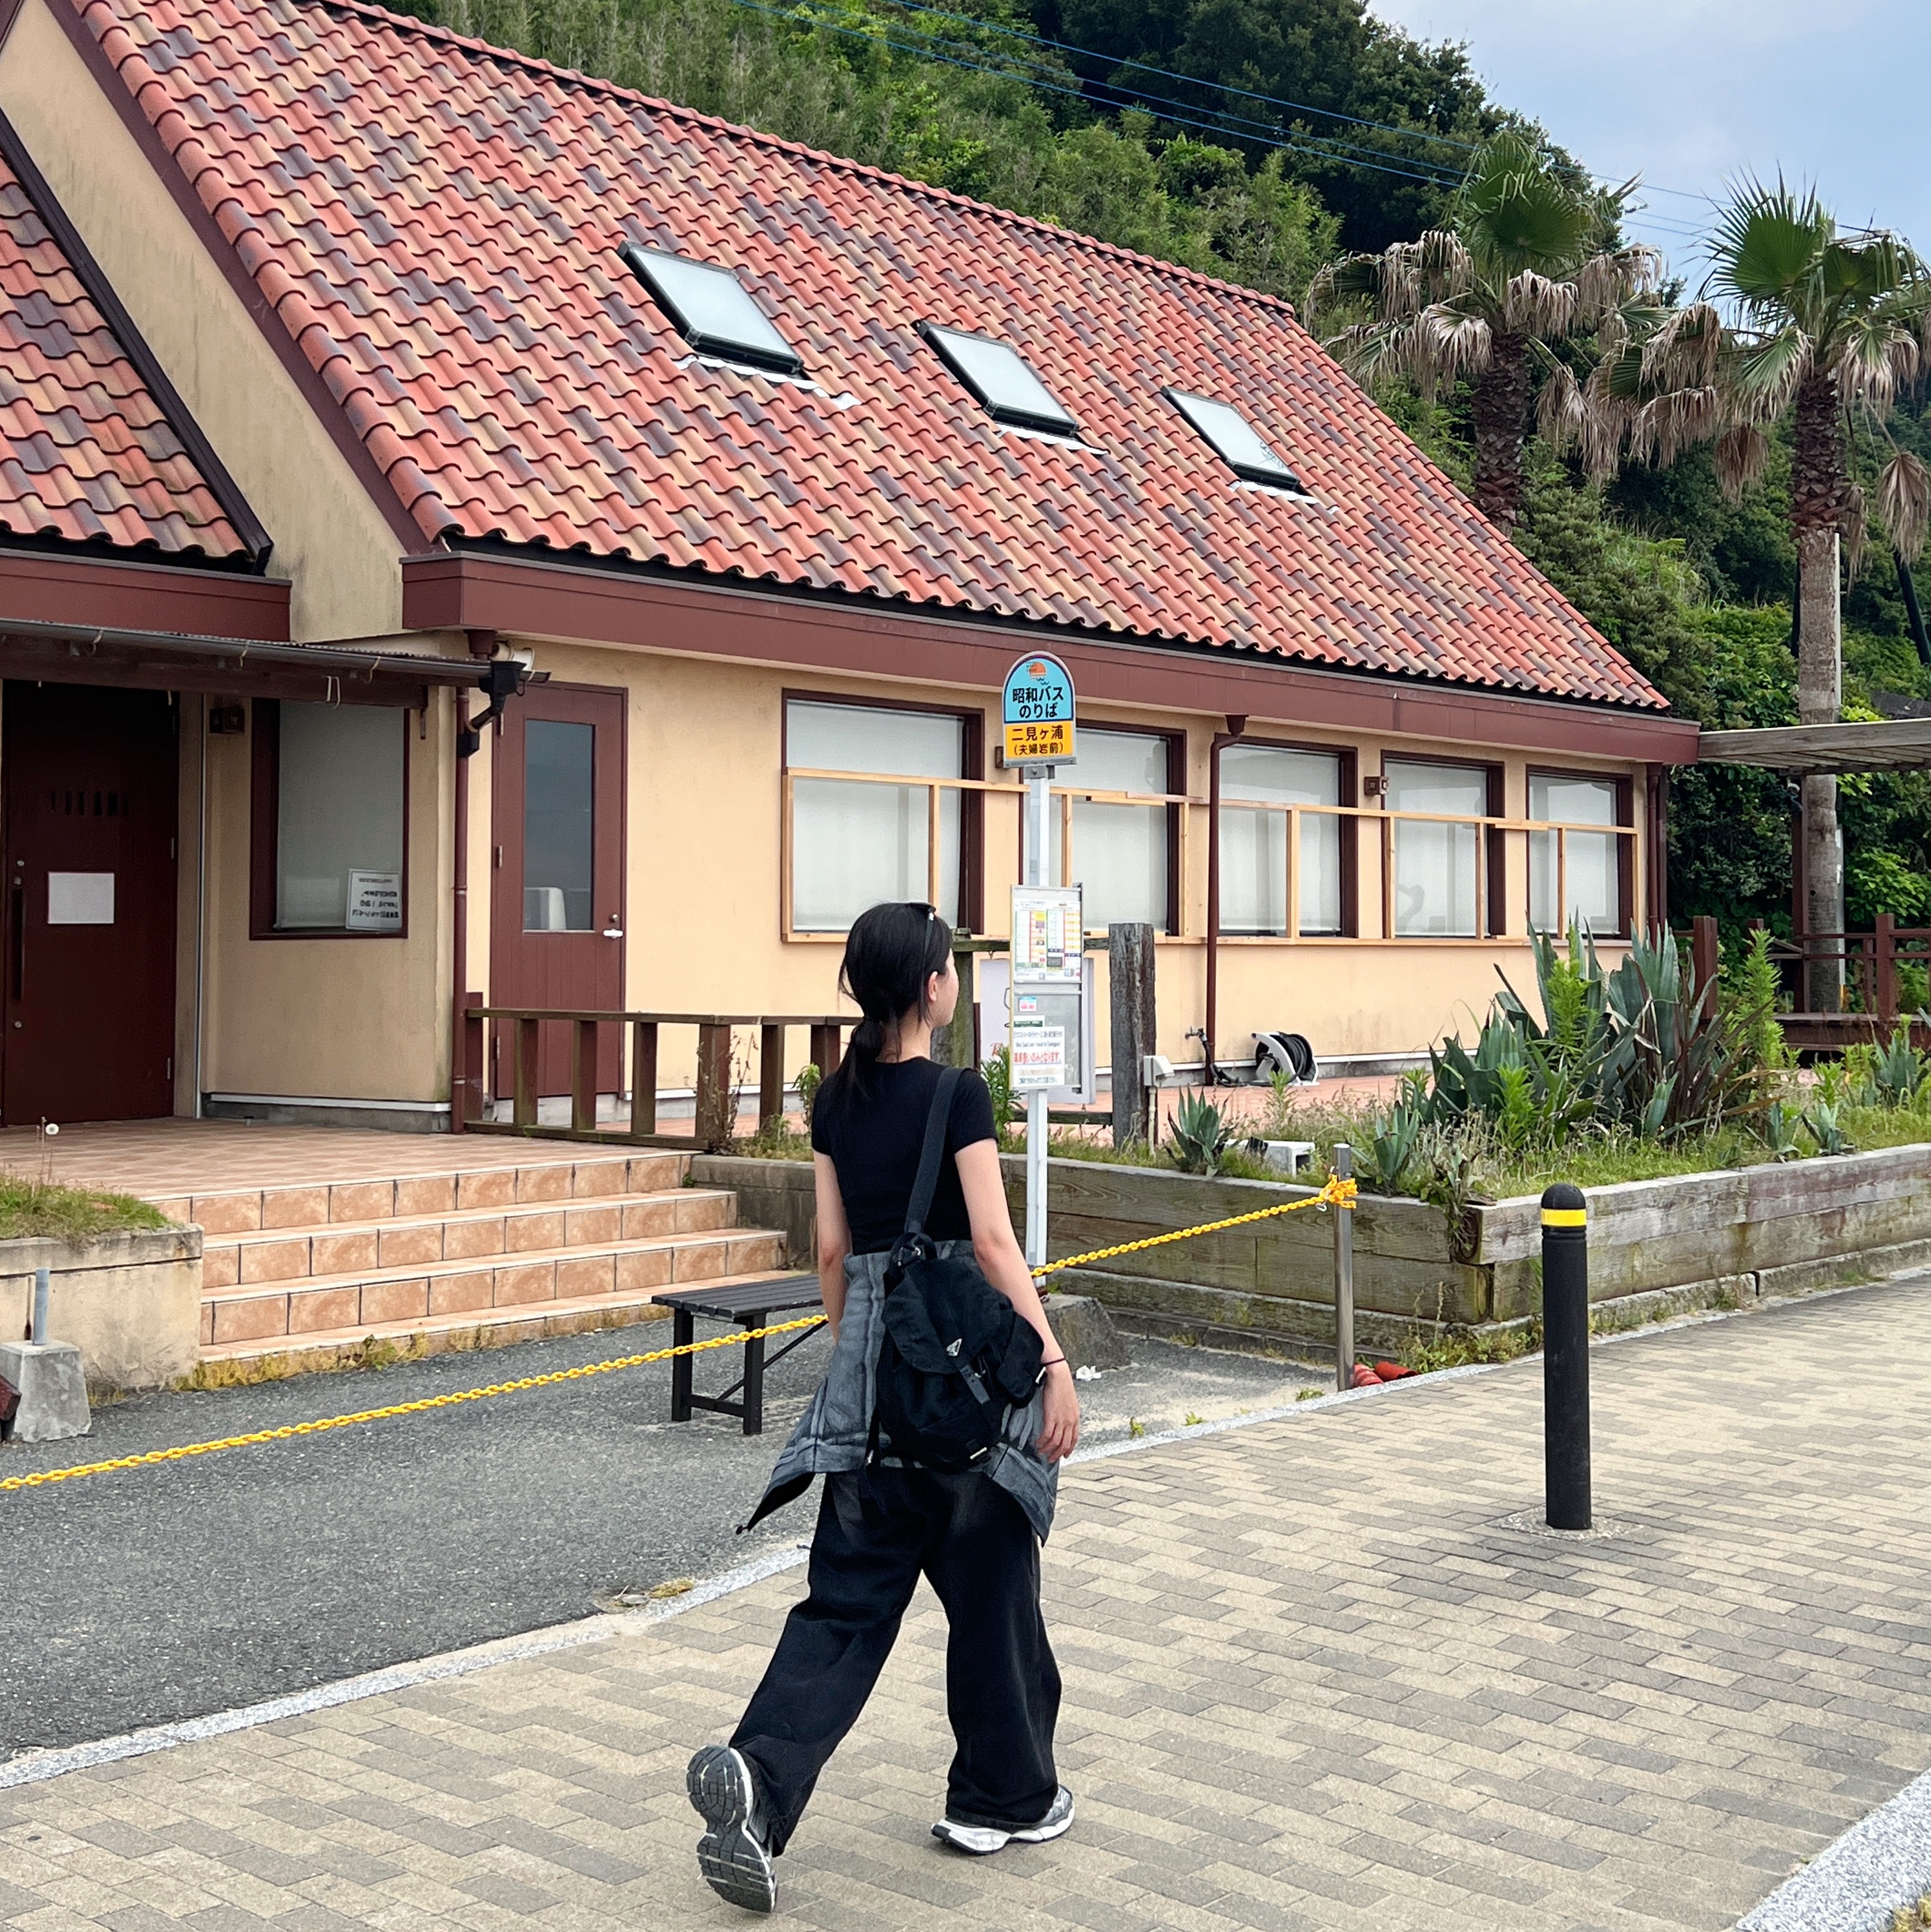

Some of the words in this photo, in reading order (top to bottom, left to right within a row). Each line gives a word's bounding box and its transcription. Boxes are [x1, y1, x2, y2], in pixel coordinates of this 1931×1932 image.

[1012, 685, 1064, 703] 昭和バス
[1019, 702, 1058, 719] のりば
